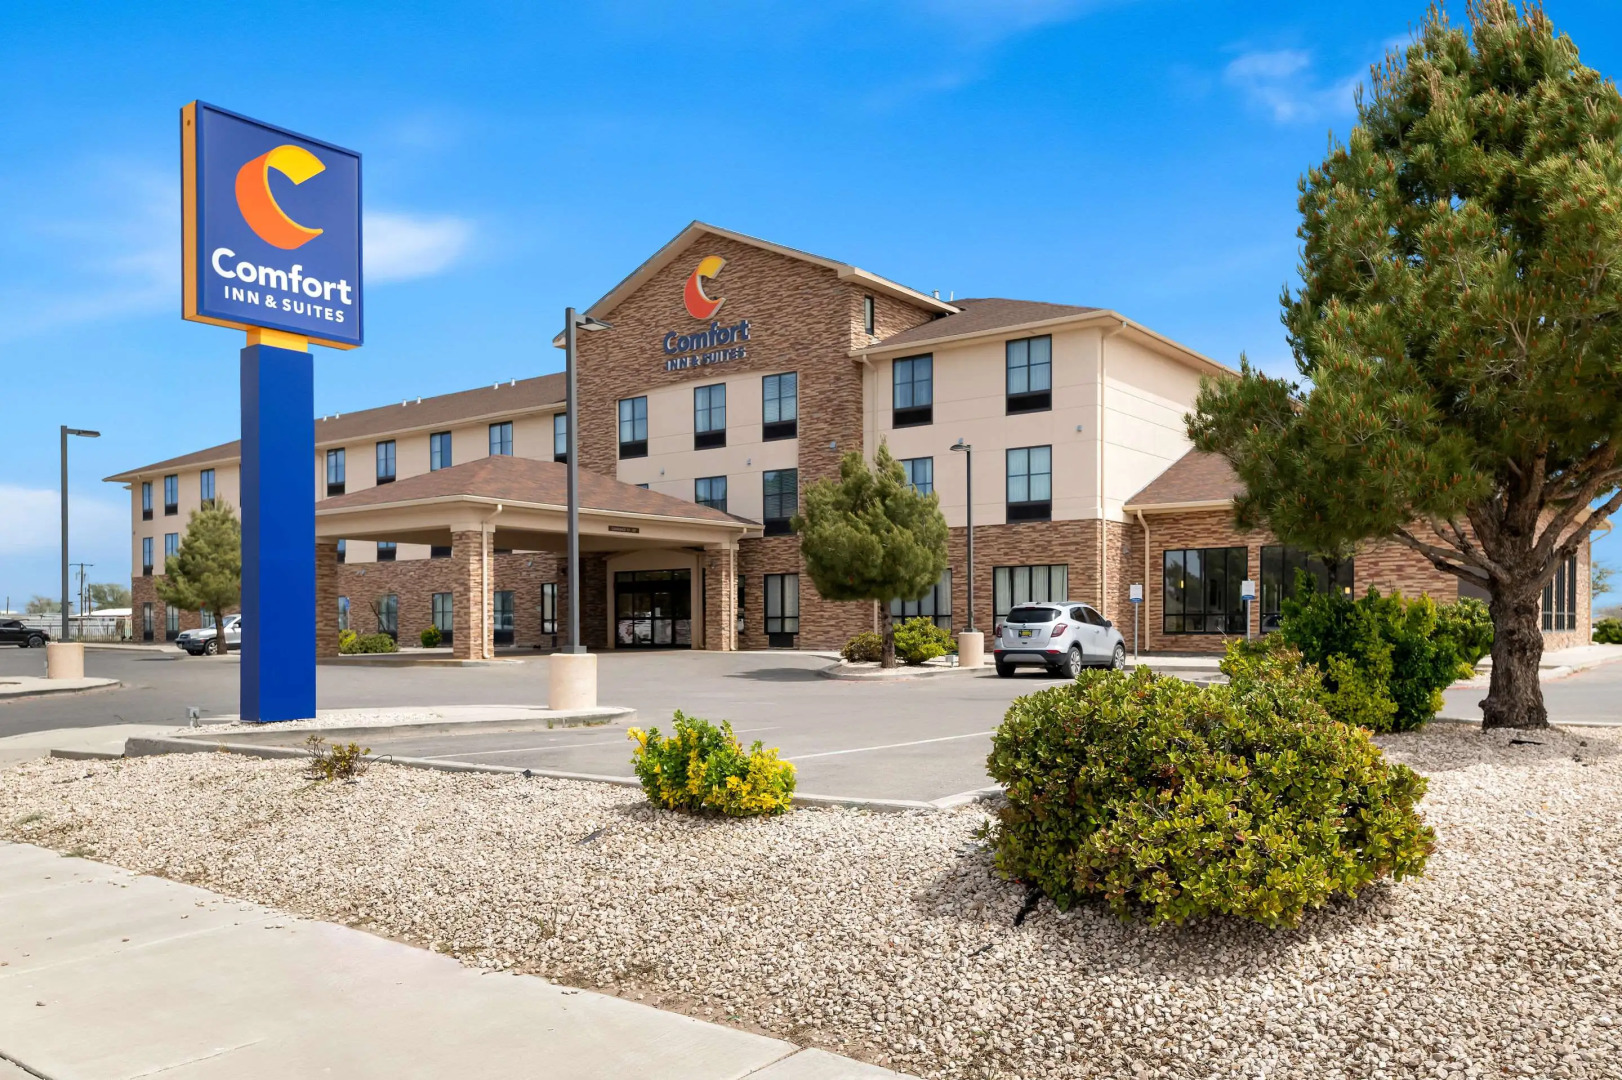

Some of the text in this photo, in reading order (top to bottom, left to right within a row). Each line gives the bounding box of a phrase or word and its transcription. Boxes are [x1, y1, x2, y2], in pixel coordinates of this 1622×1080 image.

[211, 247, 352, 305] Comfort
[224, 285, 345, 323] INN & SUITES
[663, 320, 751, 354] Comfort
[665, 346, 747, 371] INN & SUITES
